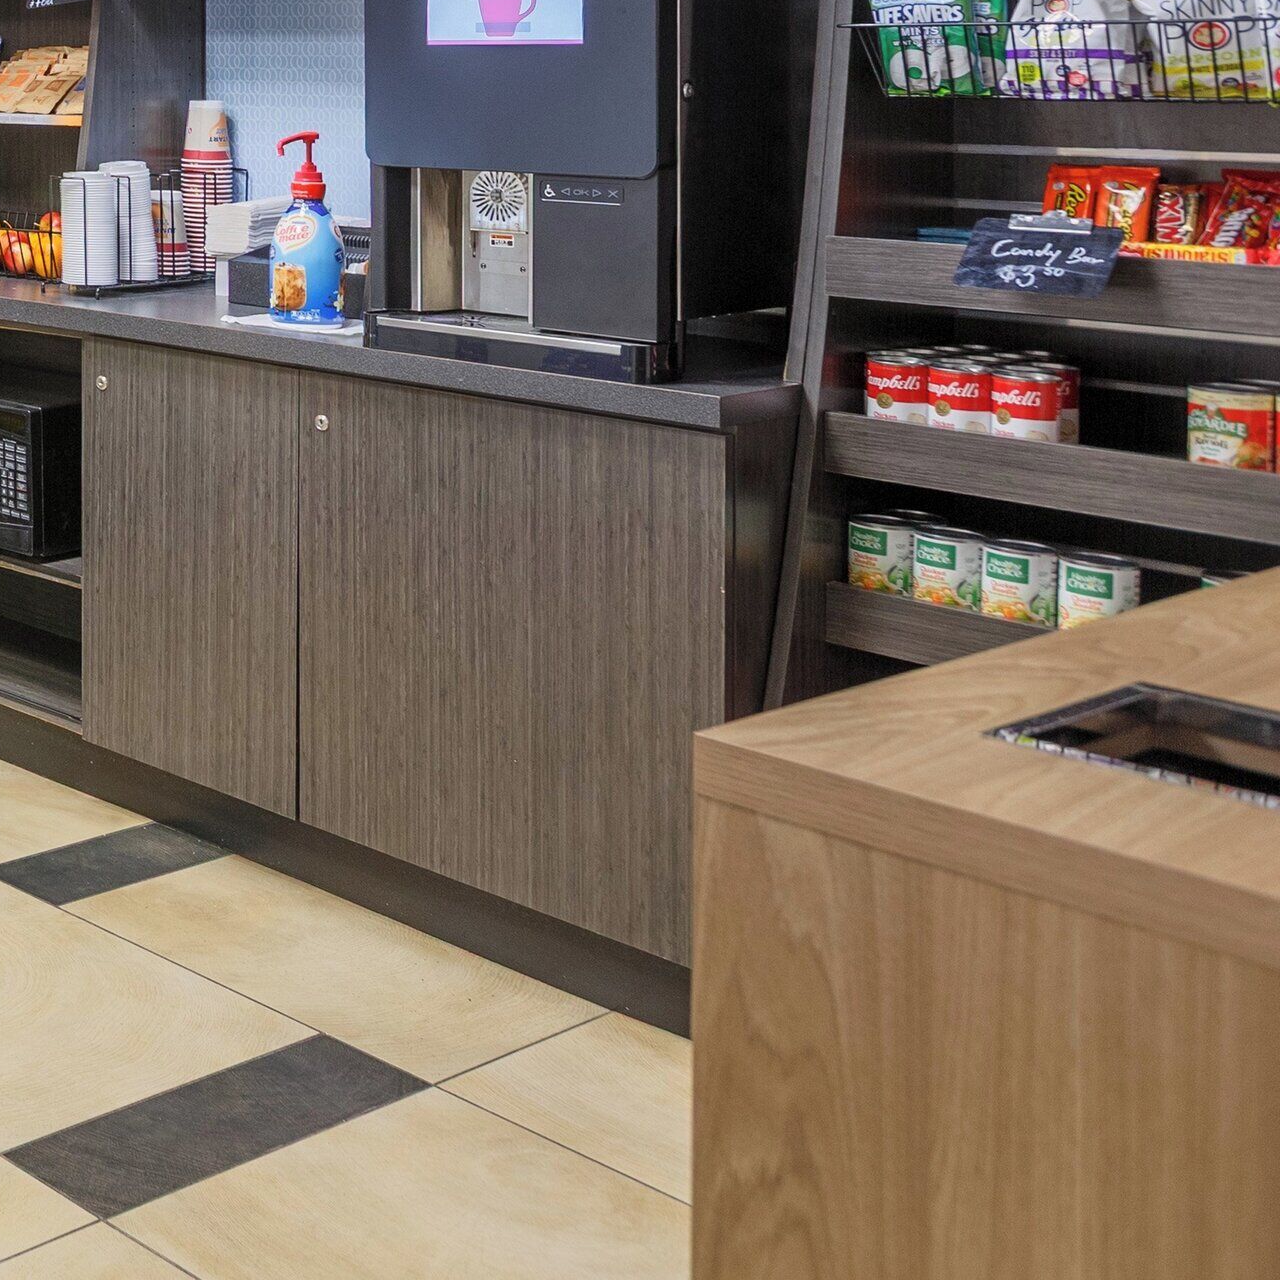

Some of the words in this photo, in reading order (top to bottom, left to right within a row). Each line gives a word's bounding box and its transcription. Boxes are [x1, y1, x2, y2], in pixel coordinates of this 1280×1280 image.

[872, 5, 902, 24] LIFE
[903, 3, 964, 24] SAVERS
[275, 223, 310, 237] Coffe
[991, 238, 1061, 266] Candy
[867, 373, 920, 391] ampbell's
[928, 380, 980, 399] ampbell's
[991, 388, 1041, 407] mpbell's
